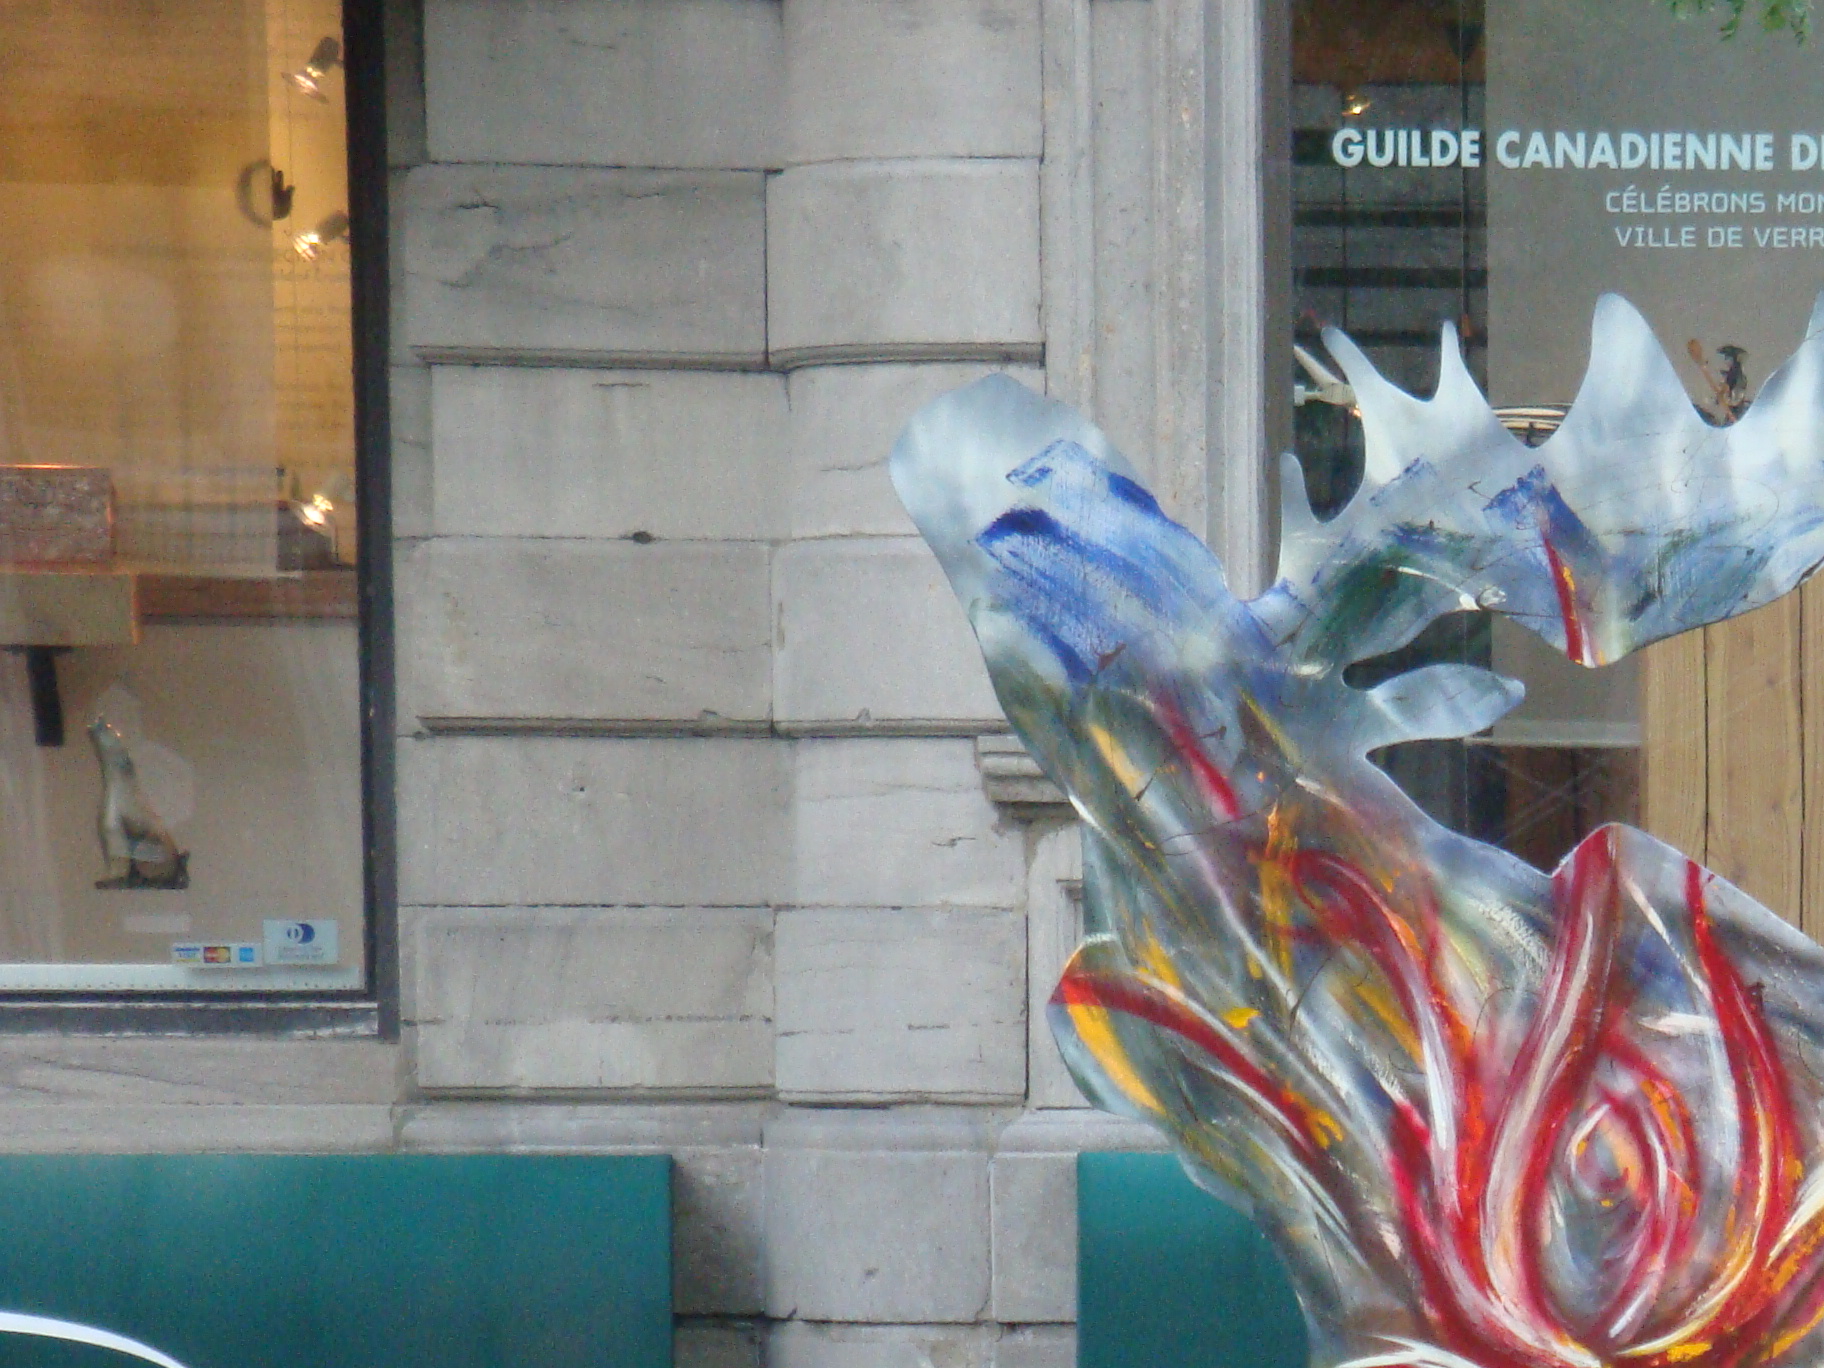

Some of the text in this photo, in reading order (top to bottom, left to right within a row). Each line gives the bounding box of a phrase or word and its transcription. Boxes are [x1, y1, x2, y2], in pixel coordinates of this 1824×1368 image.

[1331, 128, 1481, 168] GUILDE
[1496, 130, 1775, 169] CANADIENNE
[1605, 185, 1767, 214] CÉLÉBRONS
[1615, 227, 1697, 248] VILLE
[1707, 227, 1743, 248] DE
